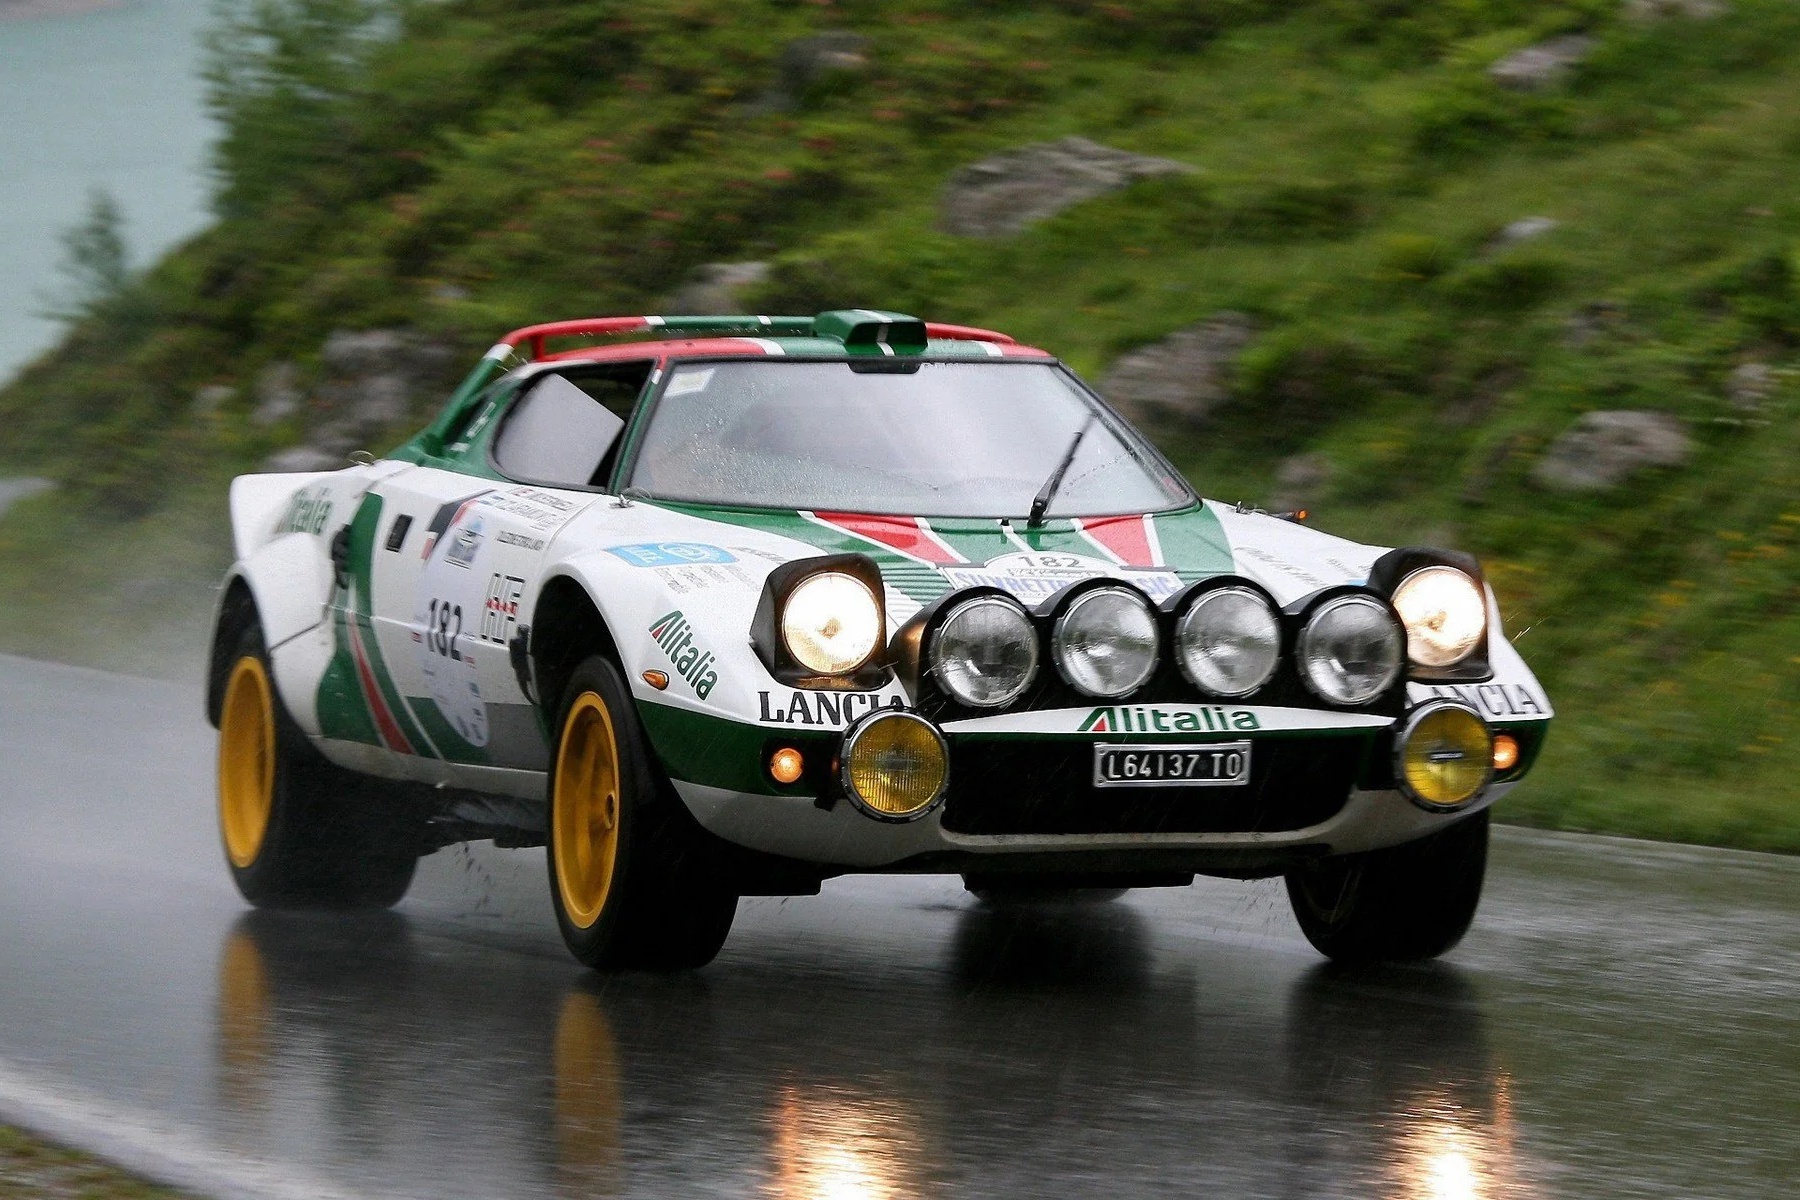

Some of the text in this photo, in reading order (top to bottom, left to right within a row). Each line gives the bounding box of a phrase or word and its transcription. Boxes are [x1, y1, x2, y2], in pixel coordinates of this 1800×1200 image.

[1018, 556, 1086, 568] 182
[426, 597, 463, 662] 182
[648, 610, 718, 701] Alitalia
[1077, 706, 1262, 732] Alitalia
[1107, 753, 1242, 779] L64137 TO
